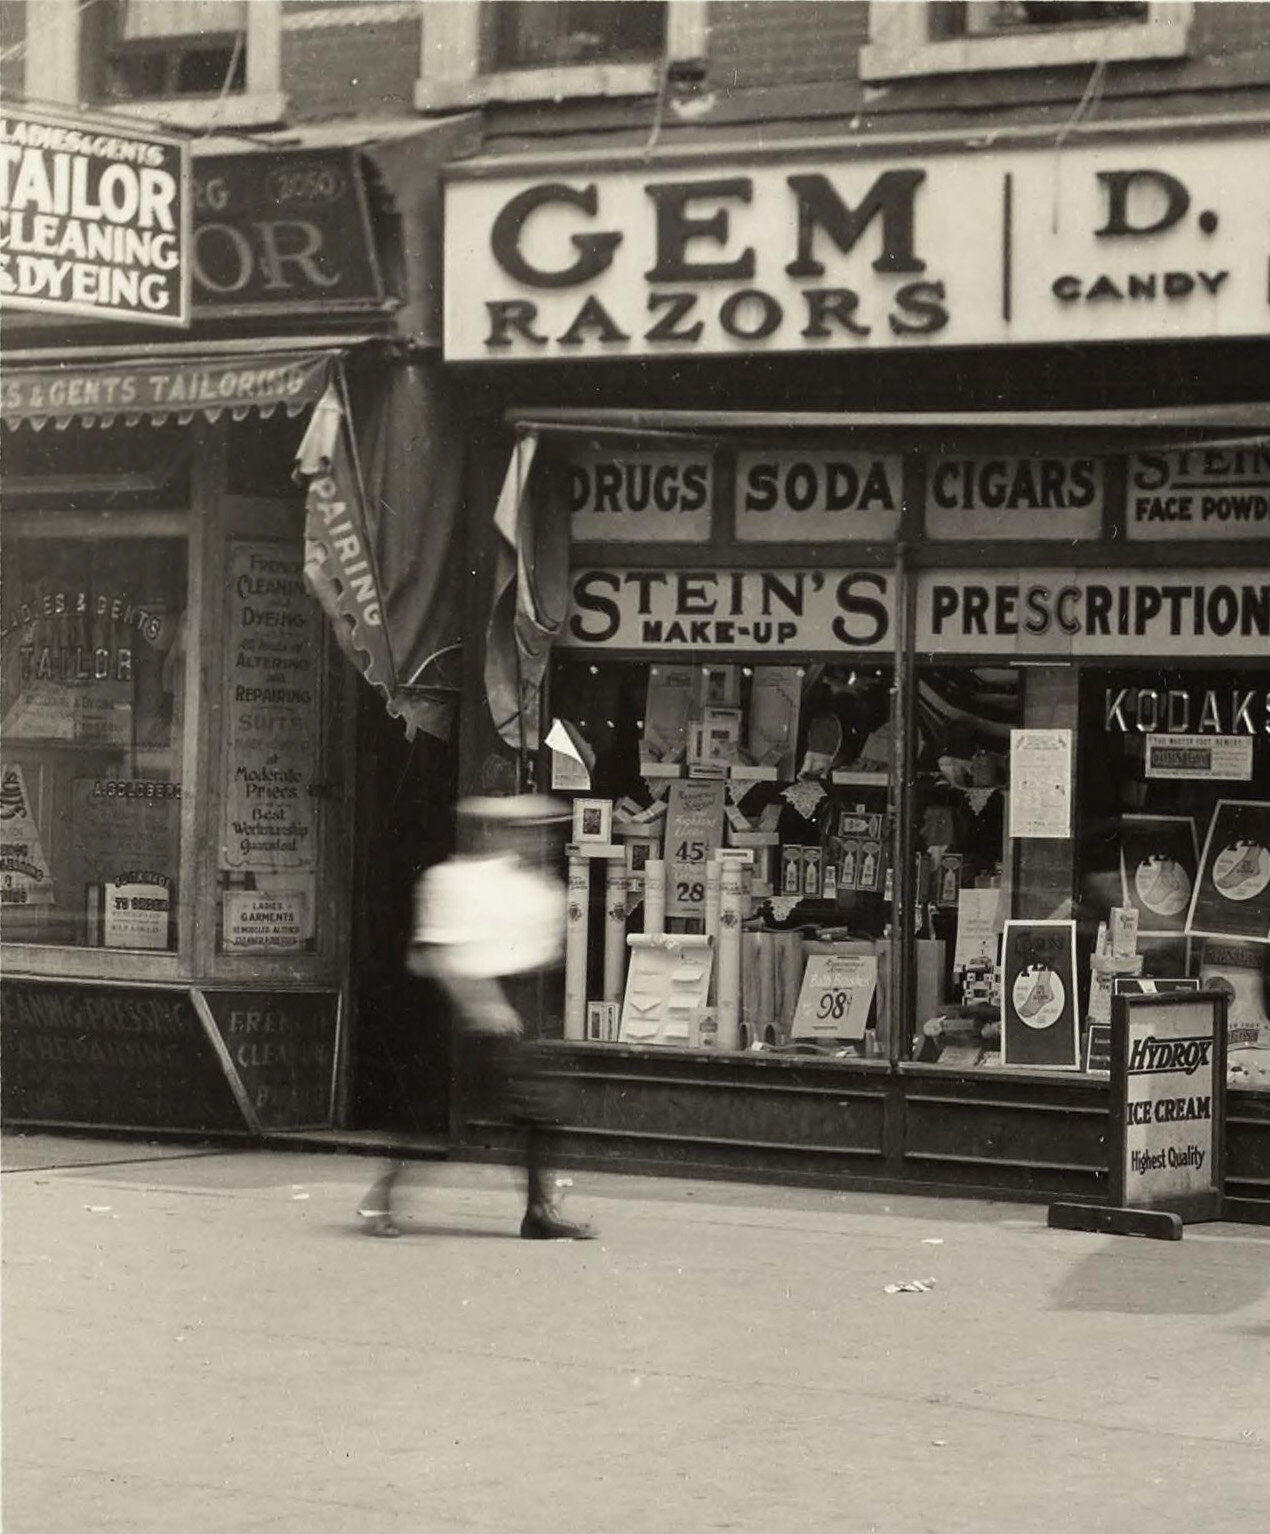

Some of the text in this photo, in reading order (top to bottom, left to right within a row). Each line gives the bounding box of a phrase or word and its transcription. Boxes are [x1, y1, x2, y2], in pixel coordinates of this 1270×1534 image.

[0, 145, 177, 231] TAILOR
[489, 167, 928, 289] GEM
[1051, 270, 1230, 302] CANDY
[483, 280, 950, 350] RAZORS
[570, 462, 708, 514] DRUGS
[745, 461, 895, 513] SODA
[931, 459, 1097, 511] CIGARS
[1135, 496, 1193, 522] FACE
[569, 569, 890, 647] STEIN'S
[642, 620, 798, 645] MAKE-UP
[1127, 1036, 1214, 1076] HYDROX
[1126, 1096, 1211, 1126] ICE CREAM
[1131, 1145, 1206, 1175] Highest Quality
